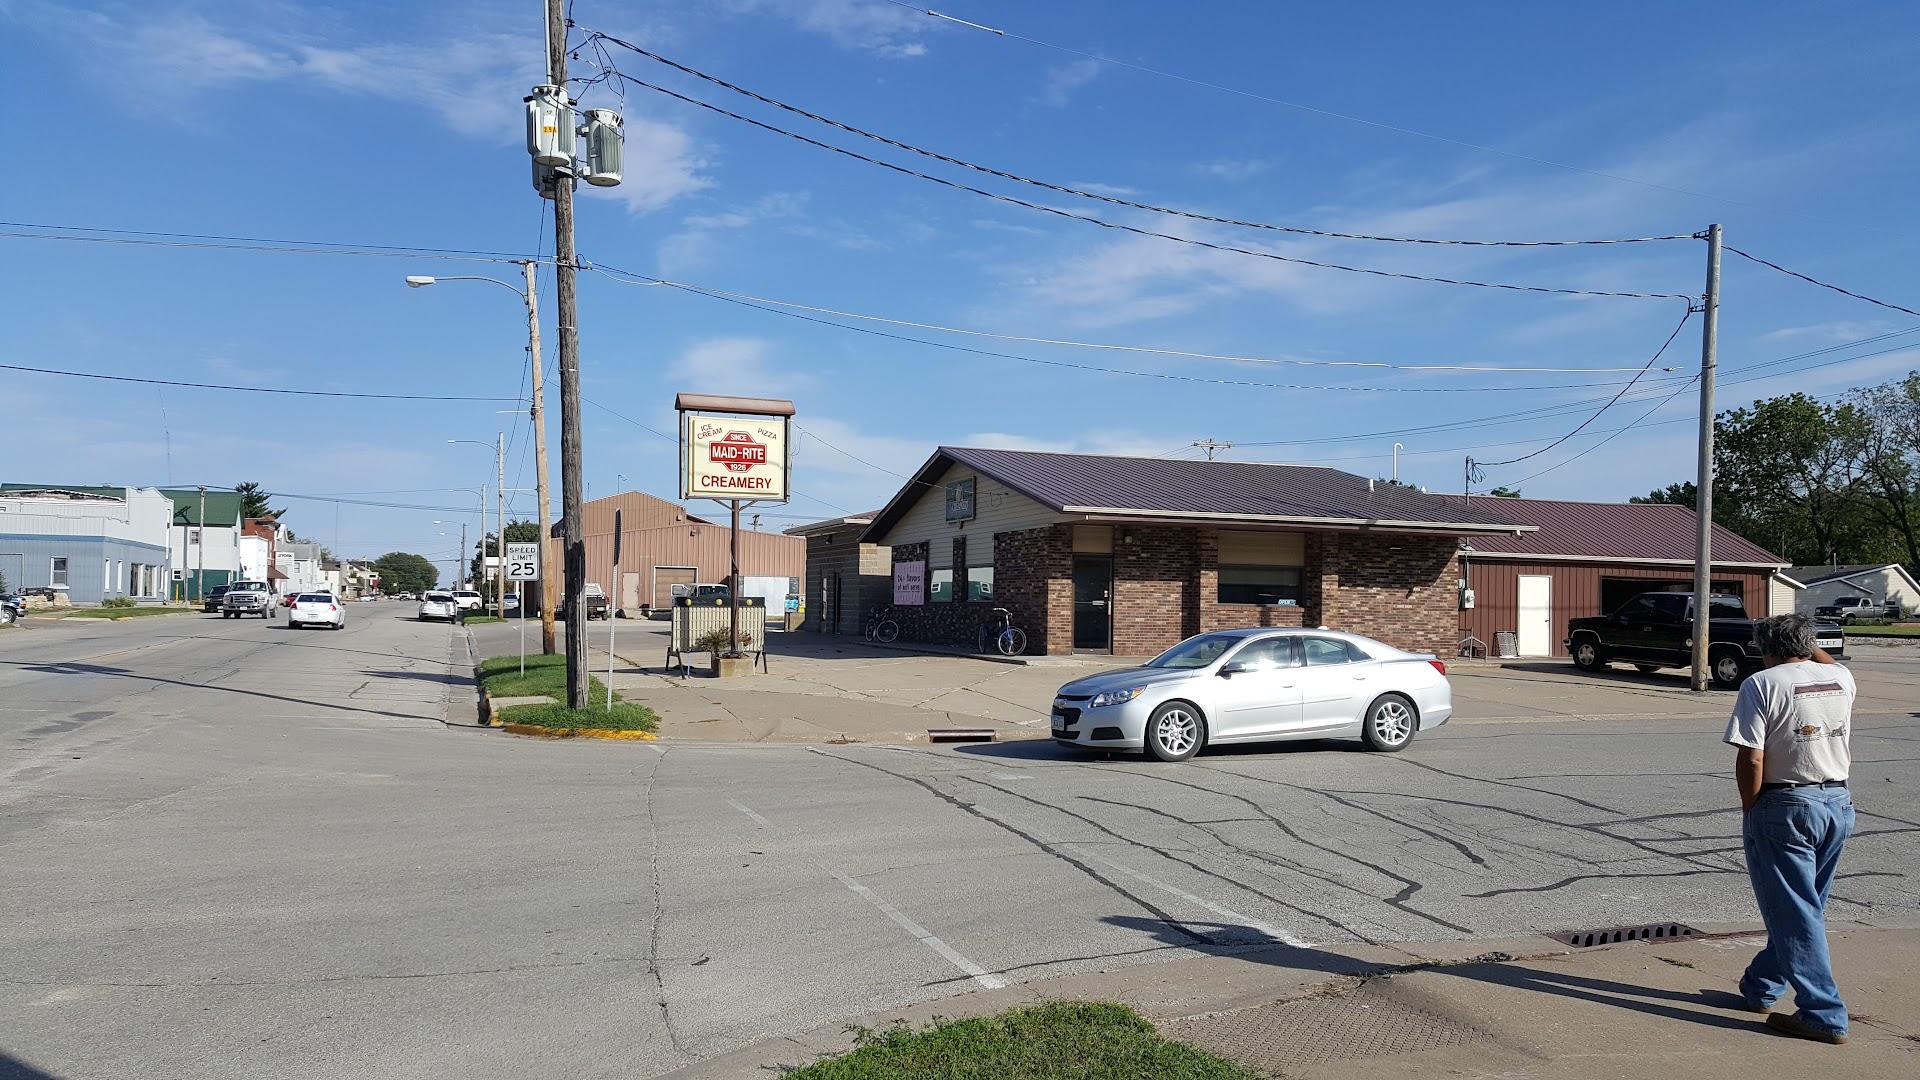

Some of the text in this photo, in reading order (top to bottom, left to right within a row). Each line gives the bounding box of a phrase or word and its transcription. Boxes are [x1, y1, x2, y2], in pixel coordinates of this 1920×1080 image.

[697, 427, 723, 440] CREAM
[700, 423, 713, 432] ICE
[757, 427, 777, 440] PIZZA
[730, 433, 747, 441] SINCE
[712, 445, 764, 460] MAID-RITE
[701, 475, 772, 489] CREAMERY
[510, 562, 535, 576] 25
